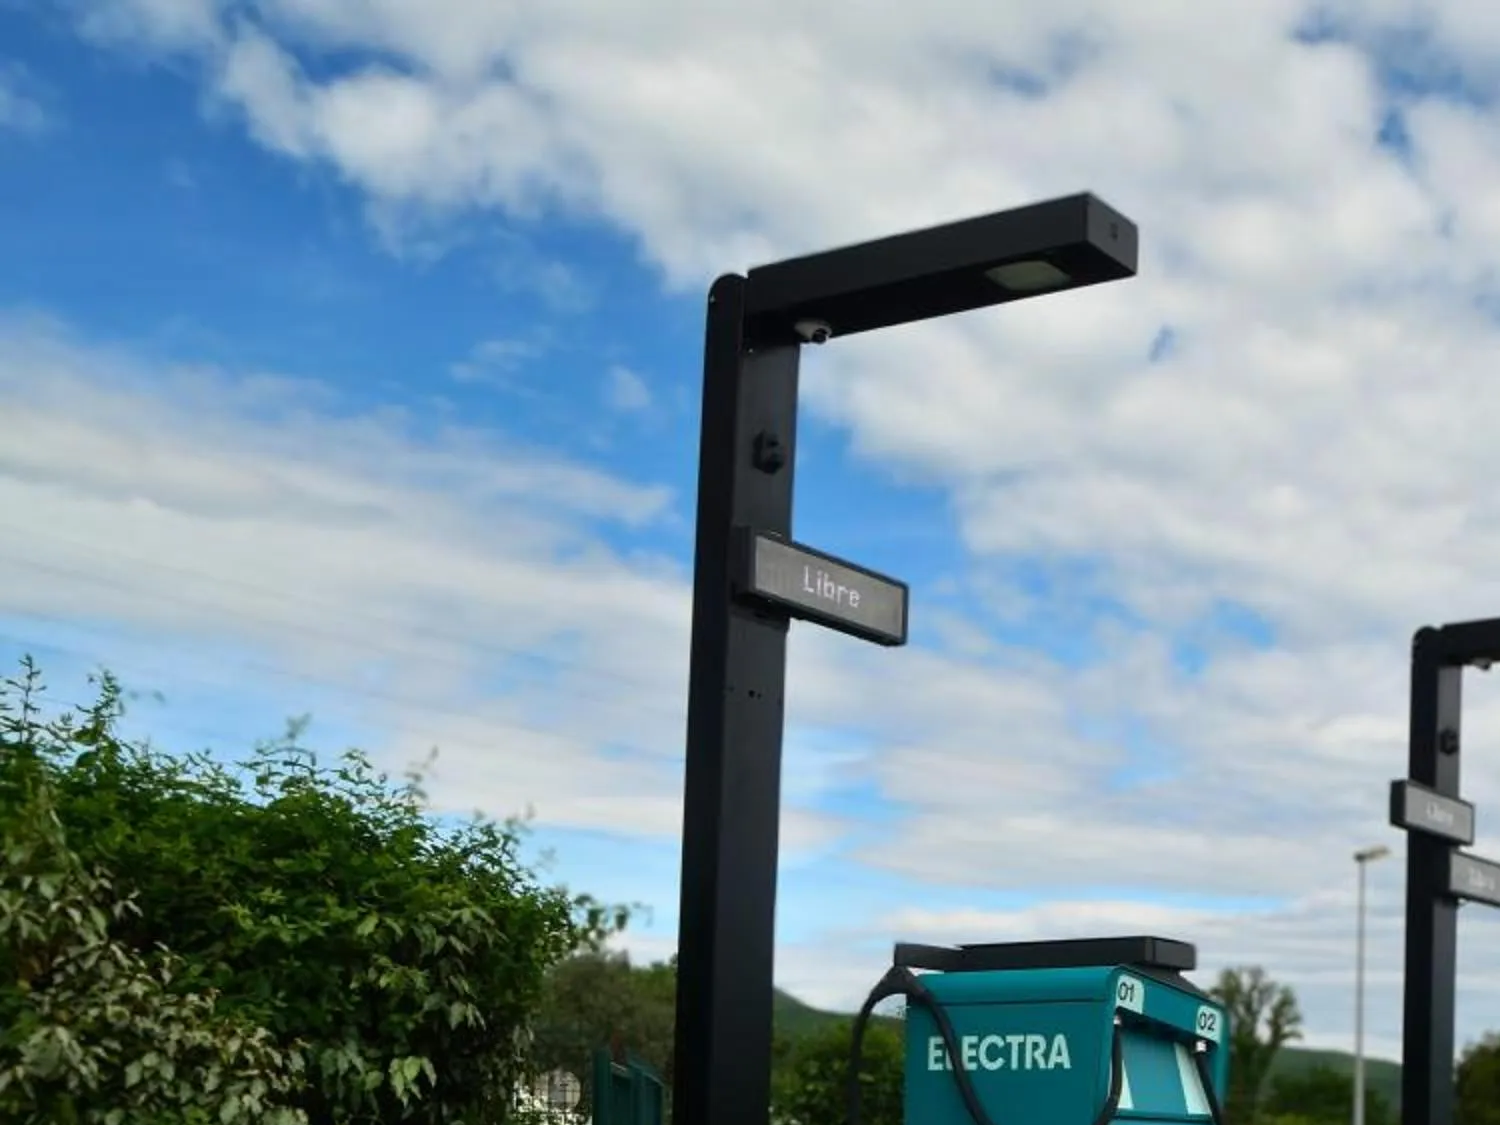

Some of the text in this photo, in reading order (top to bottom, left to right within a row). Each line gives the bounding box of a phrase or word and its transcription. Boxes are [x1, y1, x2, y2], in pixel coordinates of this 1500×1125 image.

[803, 565, 861, 608] Libre
[1118, 981, 1135, 1003] 01
[1199, 1011, 1216, 1033] 02
